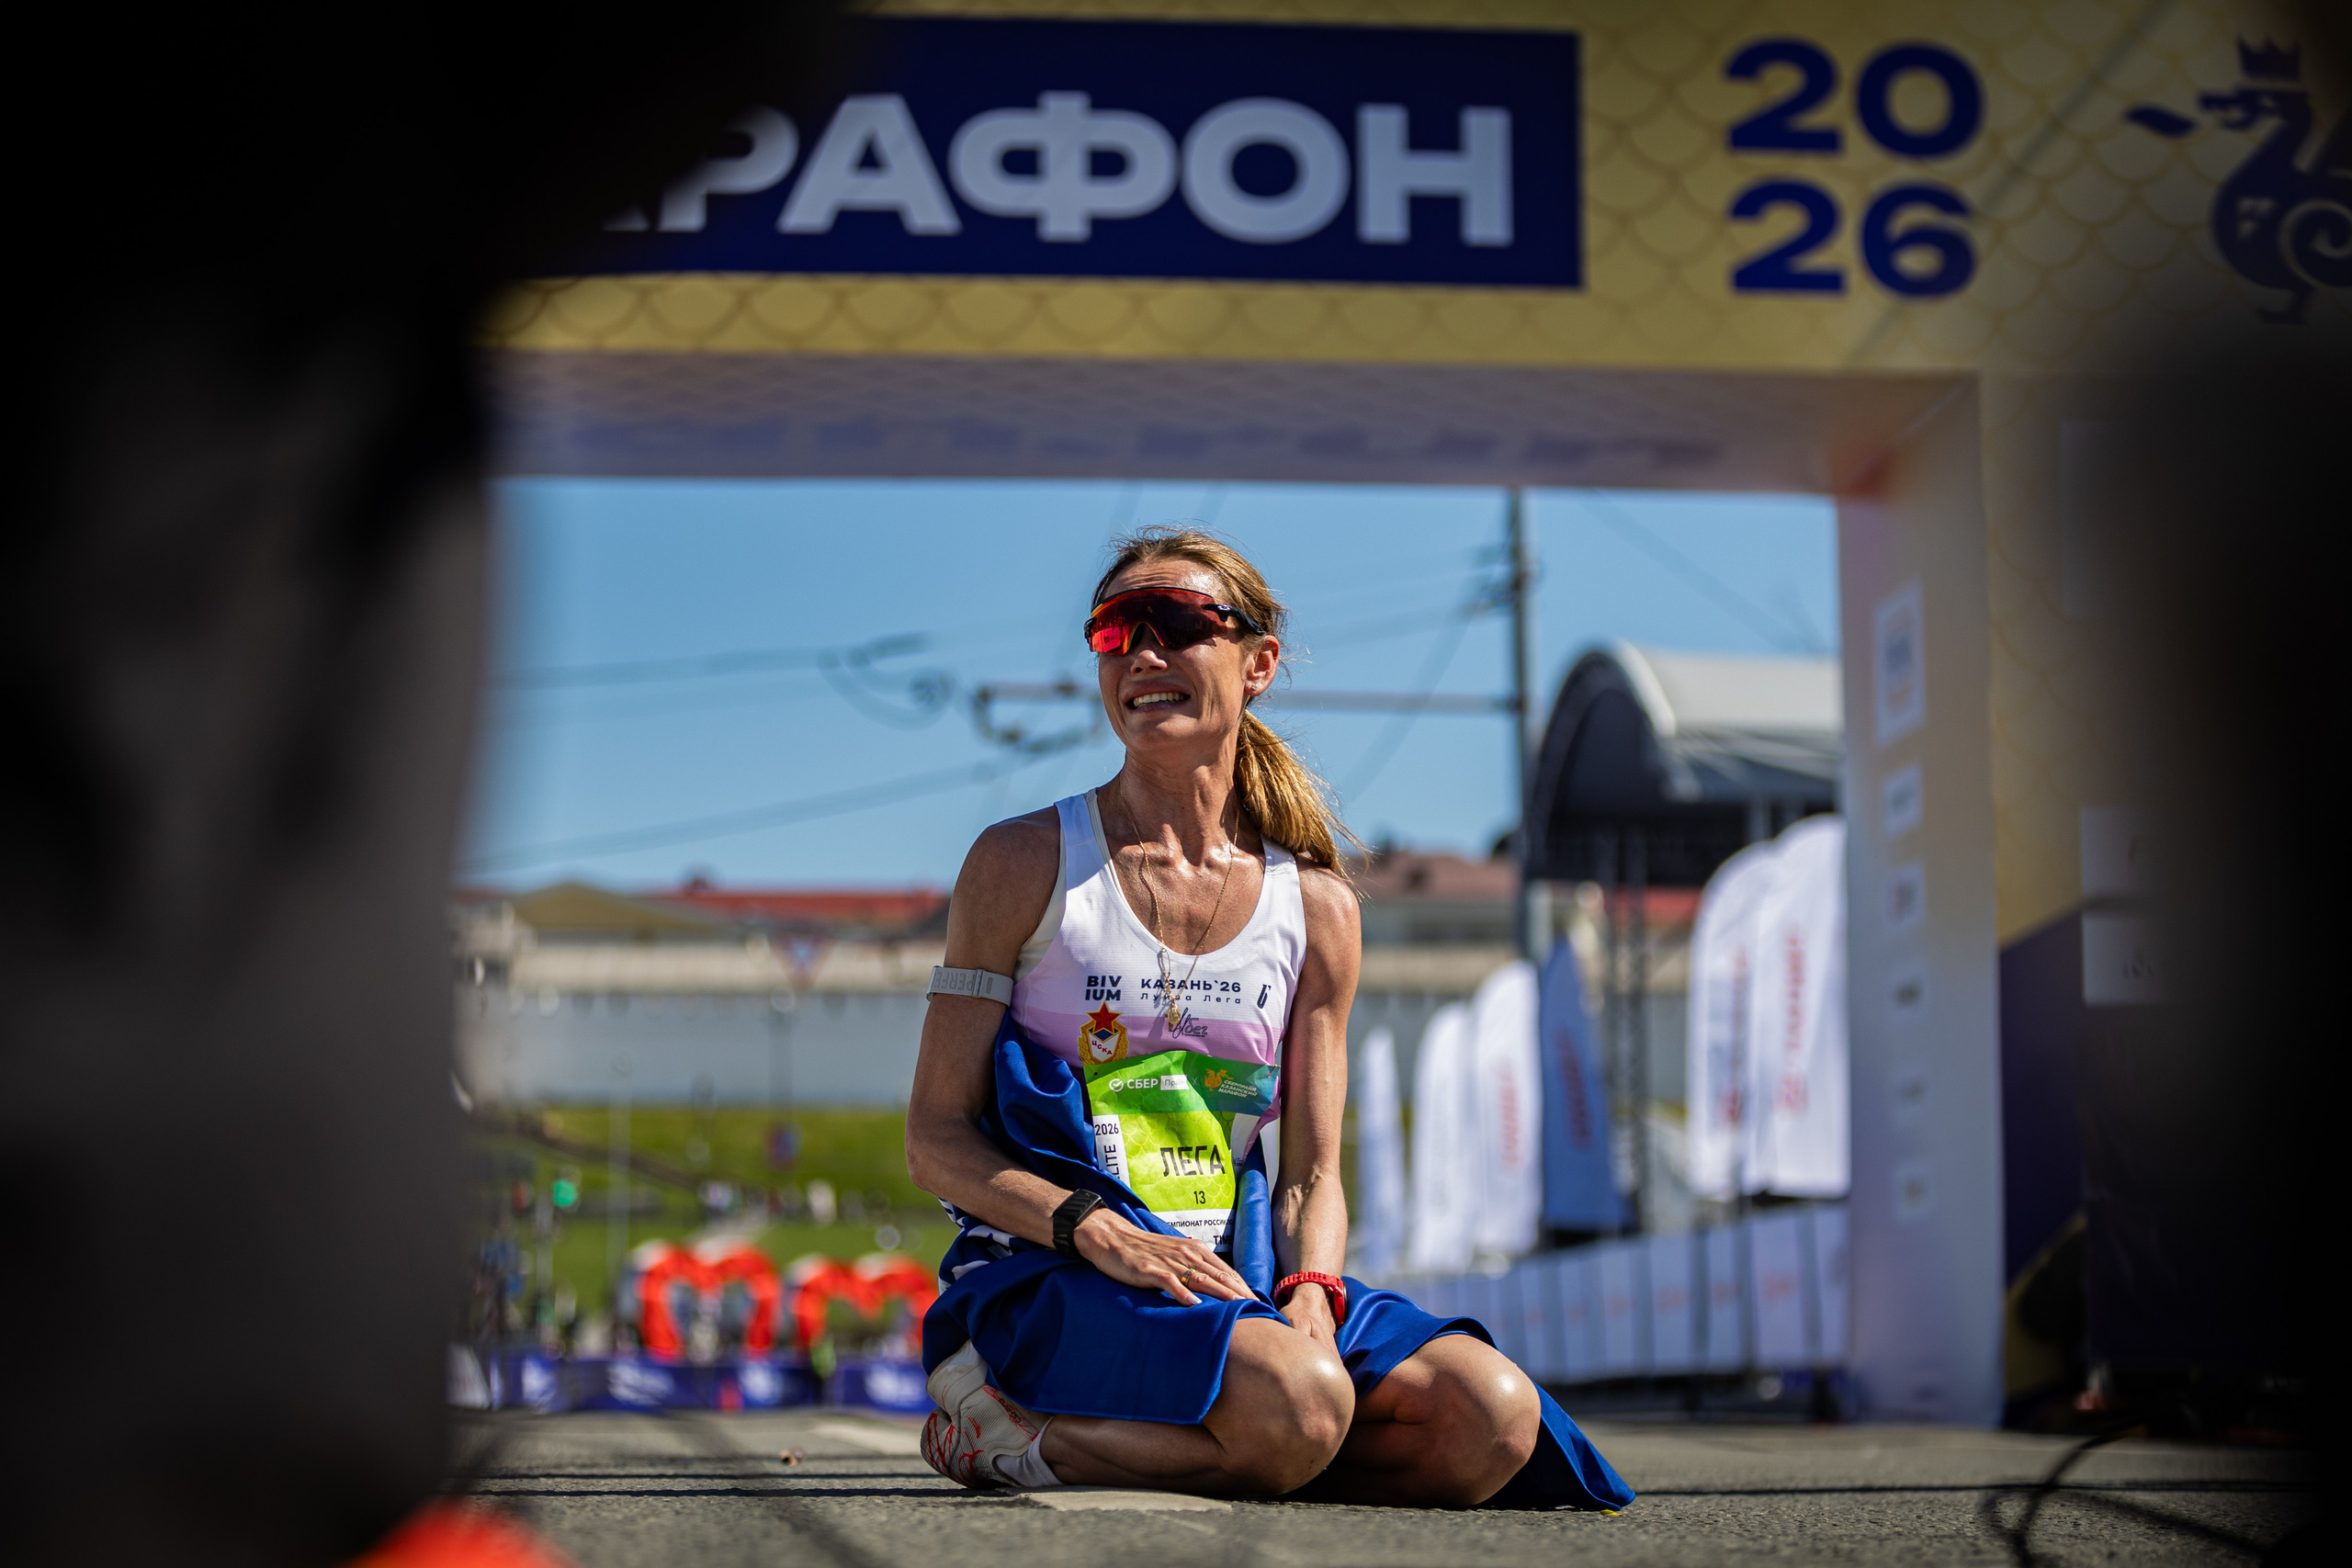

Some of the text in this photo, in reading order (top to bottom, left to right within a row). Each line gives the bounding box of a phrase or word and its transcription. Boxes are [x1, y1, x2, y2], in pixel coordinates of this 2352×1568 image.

[1723, 37, 1984, 163] 20
[603, 90, 1514, 247] РАФОН
[1726, 175, 1979, 300] 26
[1086, 975, 1122, 987] BIV
[1085, 988, 1122, 1001] IUM
[1204, 994, 1241, 1004] Лега
[1091, 1040, 1113, 1055] ЦСКА
[1126, 1077, 1159, 1089] СБЕР
[1217, 1088, 1248, 1099] МАРАФОН
[1220, 1084, 1258, 1097] КАЗАНСКИЙ
[1094, 1122, 1120, 1136] 2026
[1104, 1144, 1120, 1179] LITE
[1159, 1145, 1226, 1177] ЛЕГА
[1193, 1190, 1206, 1204] 13
